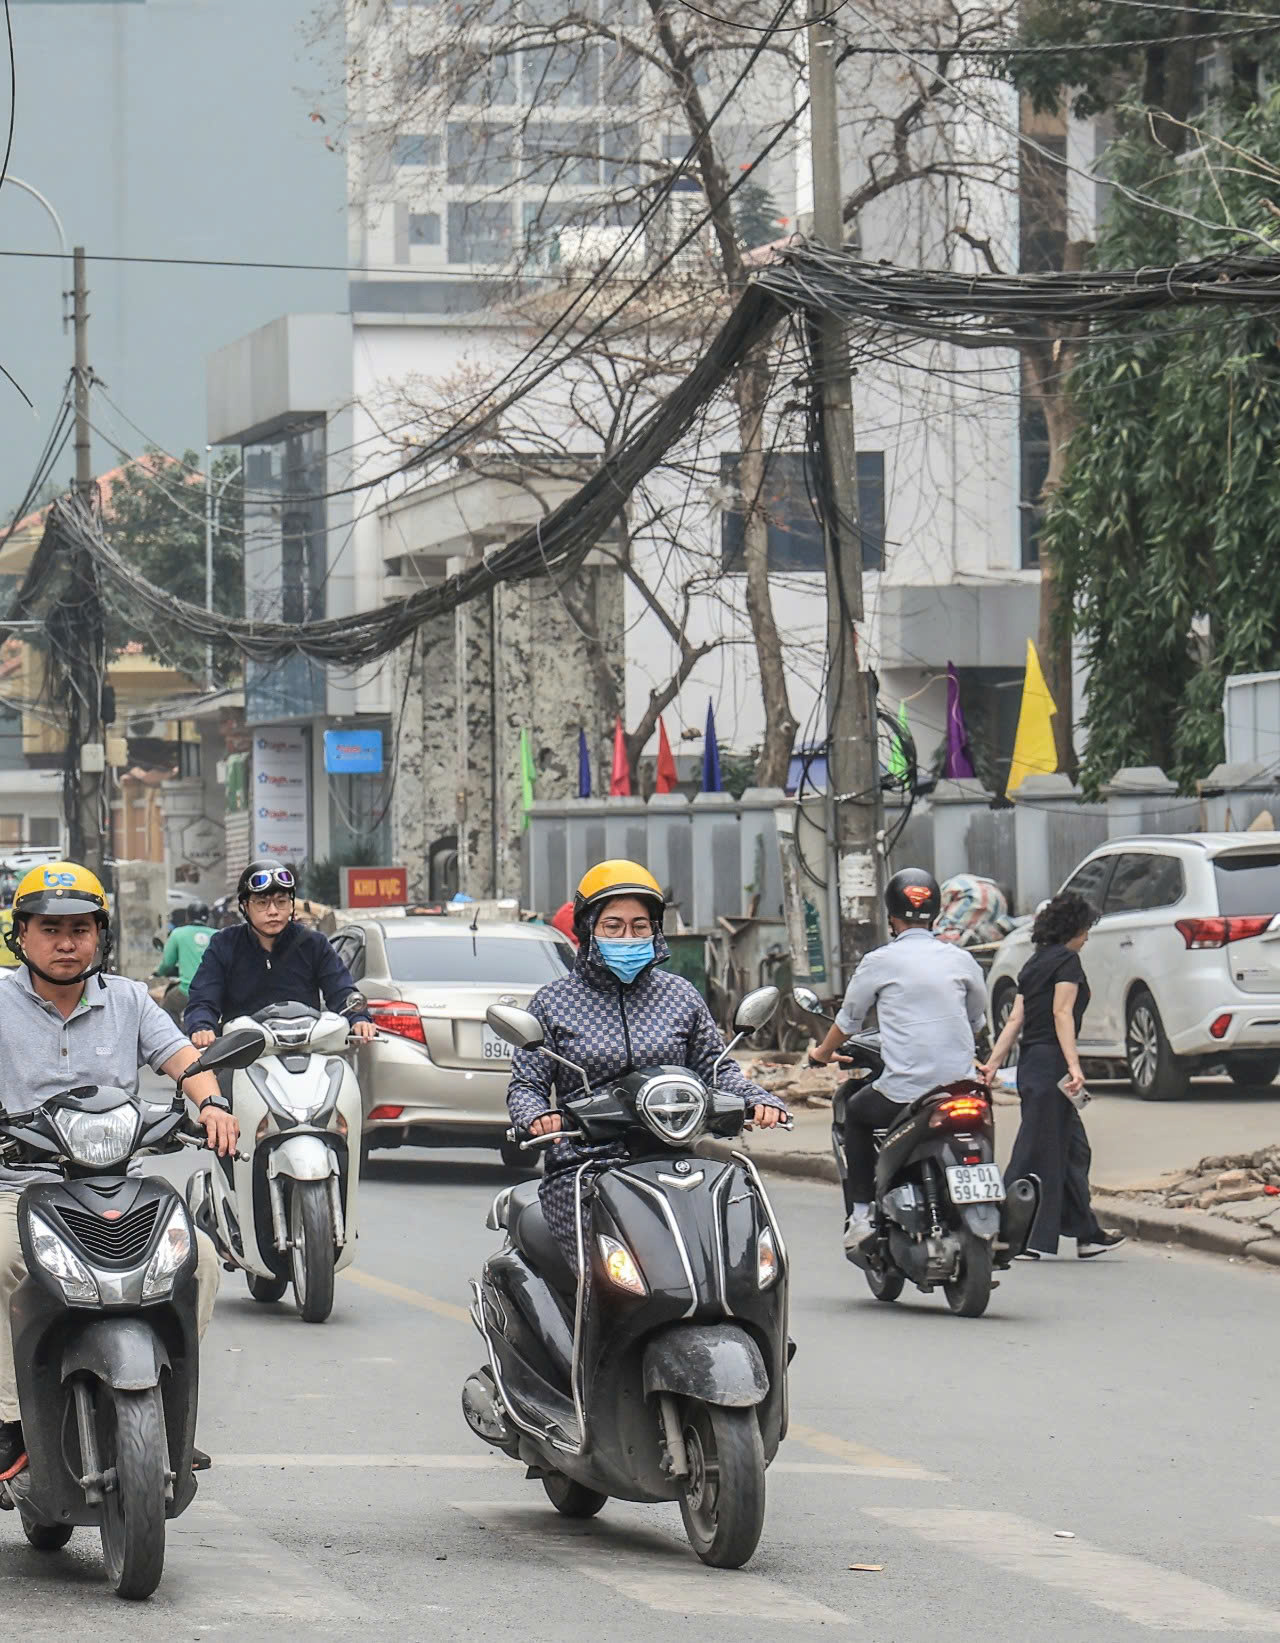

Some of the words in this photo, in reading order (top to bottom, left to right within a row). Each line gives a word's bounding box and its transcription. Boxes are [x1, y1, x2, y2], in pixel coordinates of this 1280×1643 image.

[43, 870, 76, 887] be
[354, 878, 377, 897] KHU
[378, 876, 401, 900] VỰC
[484, 1042, 512, 1059] 894
[953, 1183, 1001, 1201] 594.22
